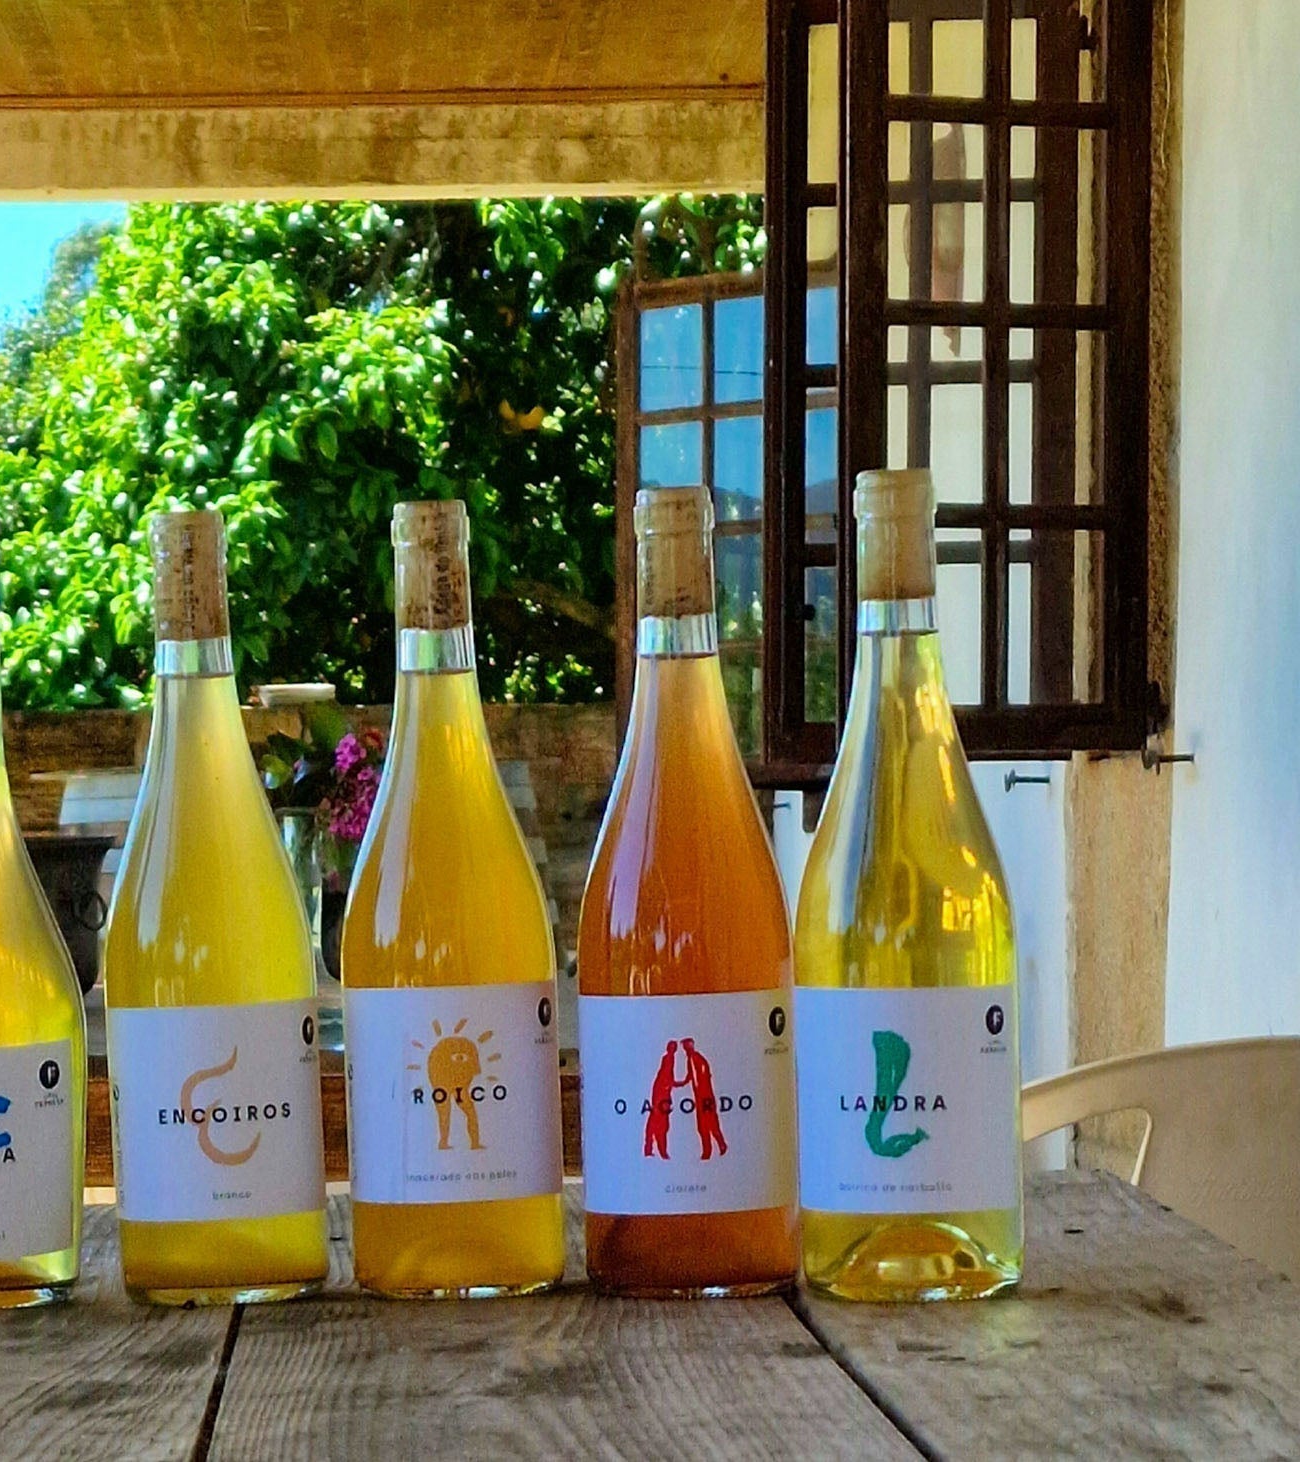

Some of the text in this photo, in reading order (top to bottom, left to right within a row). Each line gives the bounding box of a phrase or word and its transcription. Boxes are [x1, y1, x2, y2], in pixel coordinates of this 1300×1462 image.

[412, 1085, 507, 1104] ROICO
[840, 1095, 948, 1112] LANDRA
[158, 1102, 292, 1125] ENCOIROS
[614, 1095, 753, 1115] O ACORDO
